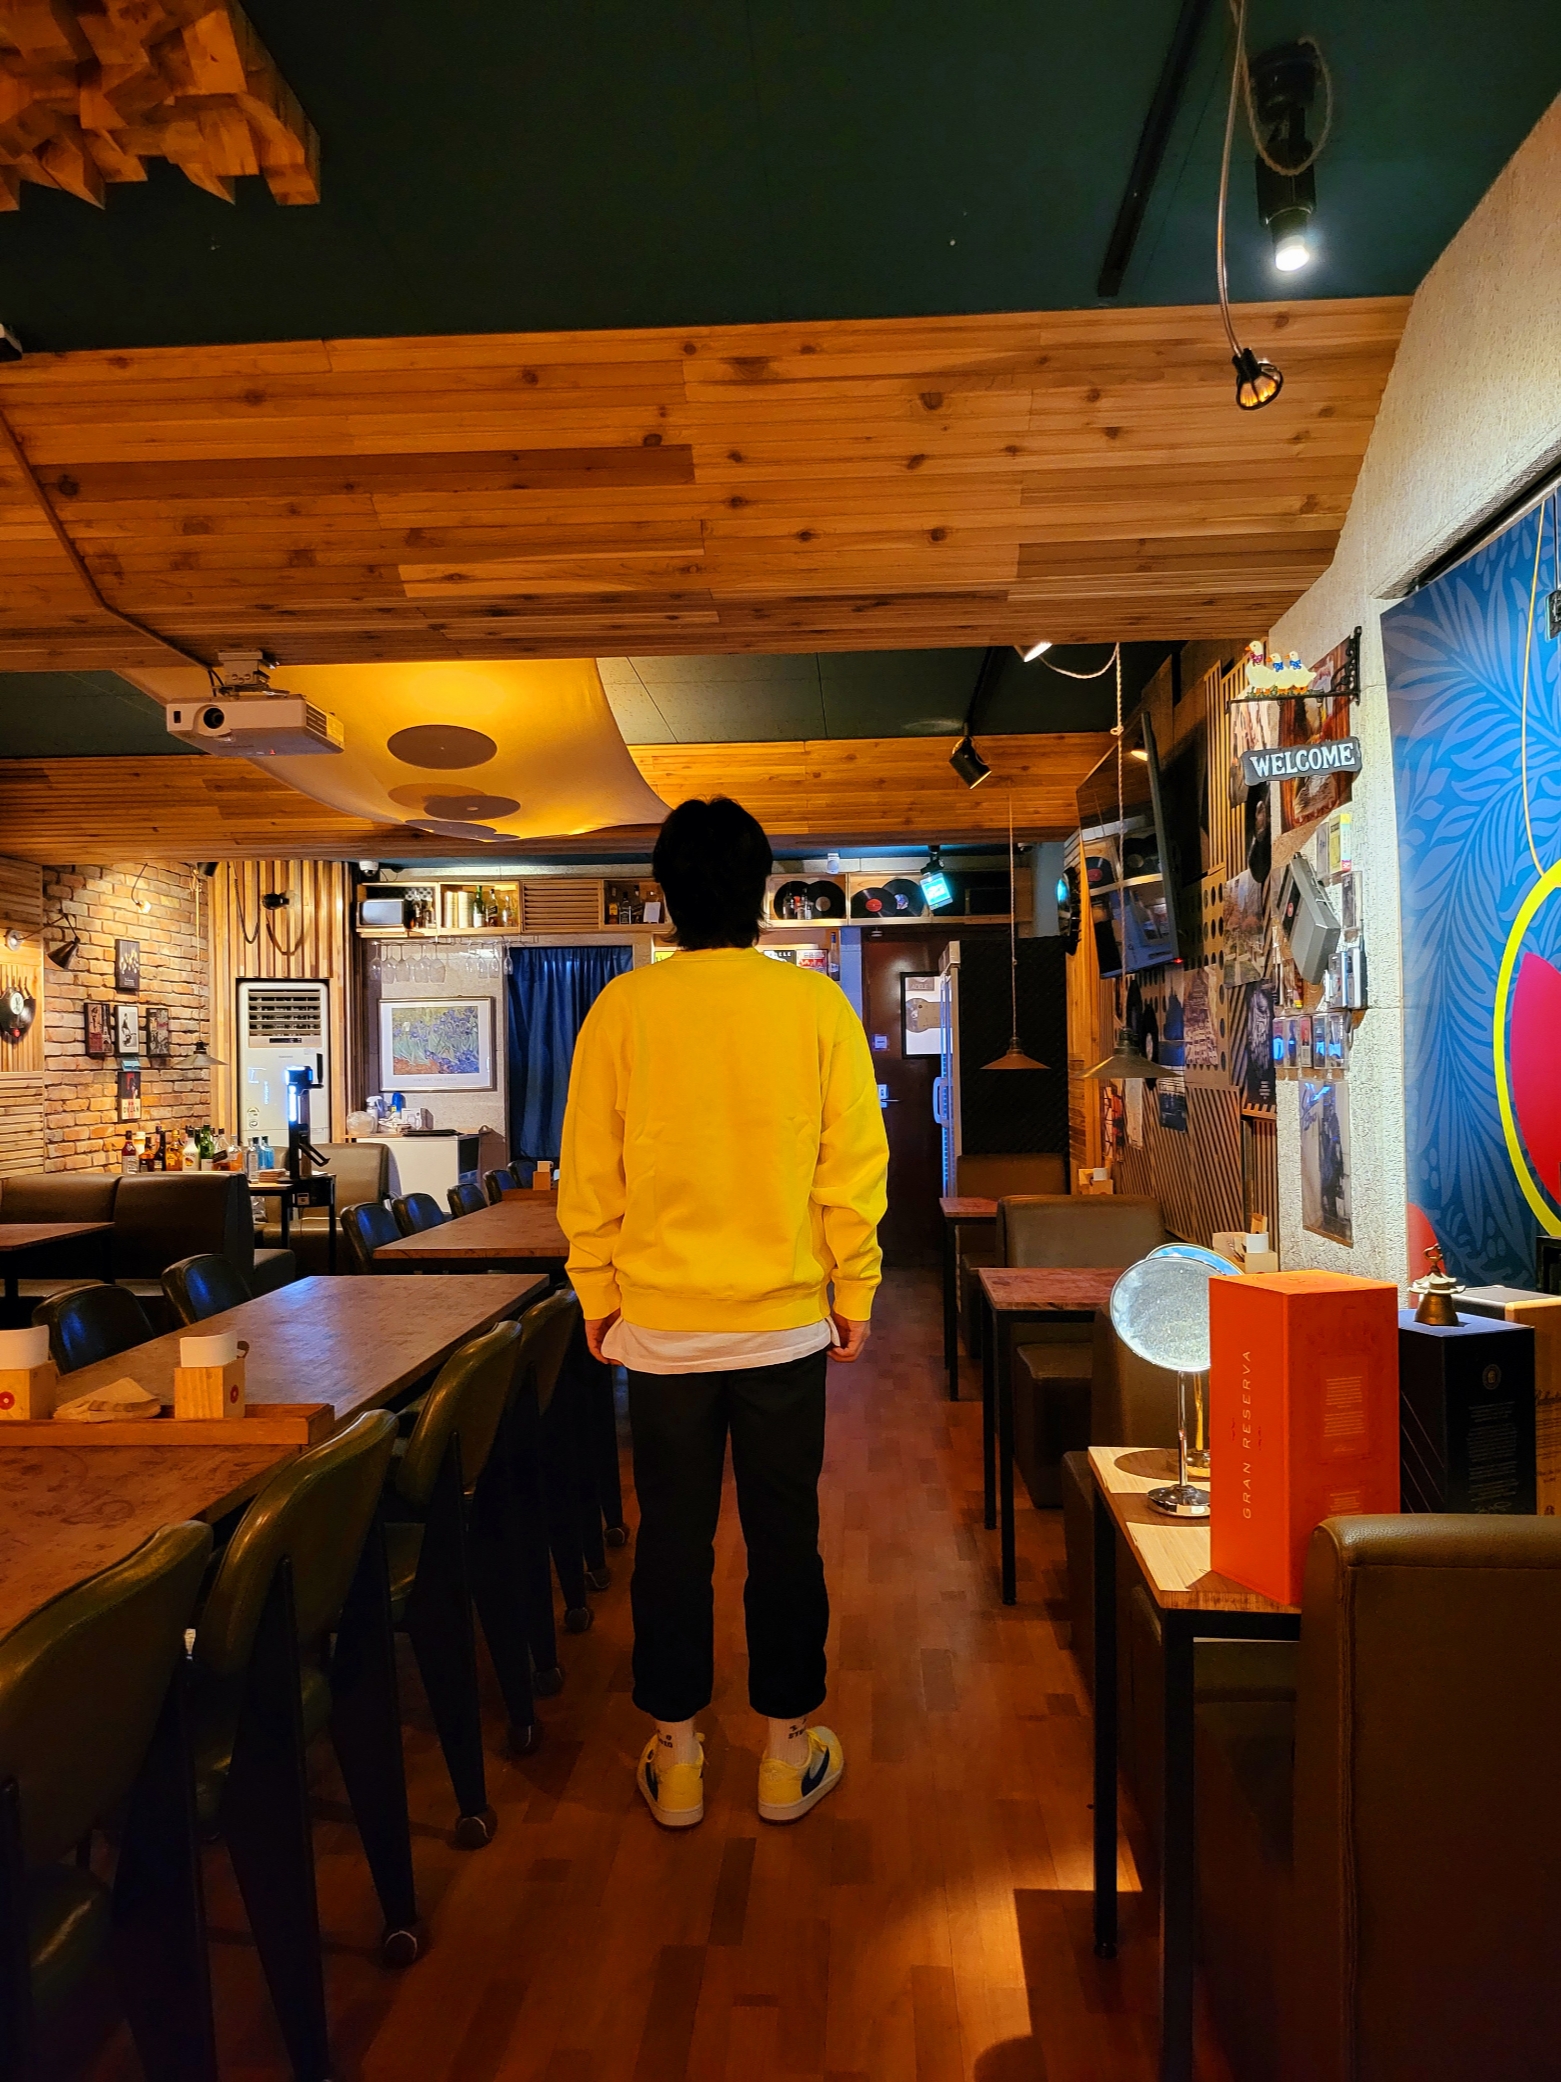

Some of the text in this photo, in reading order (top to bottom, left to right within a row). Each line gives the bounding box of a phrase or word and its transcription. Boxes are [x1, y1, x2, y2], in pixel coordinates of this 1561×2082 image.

[1250, 743, 1355, 778] WELCOME
[1242, 1351, 1252, 1519] GRAN RESERVA
